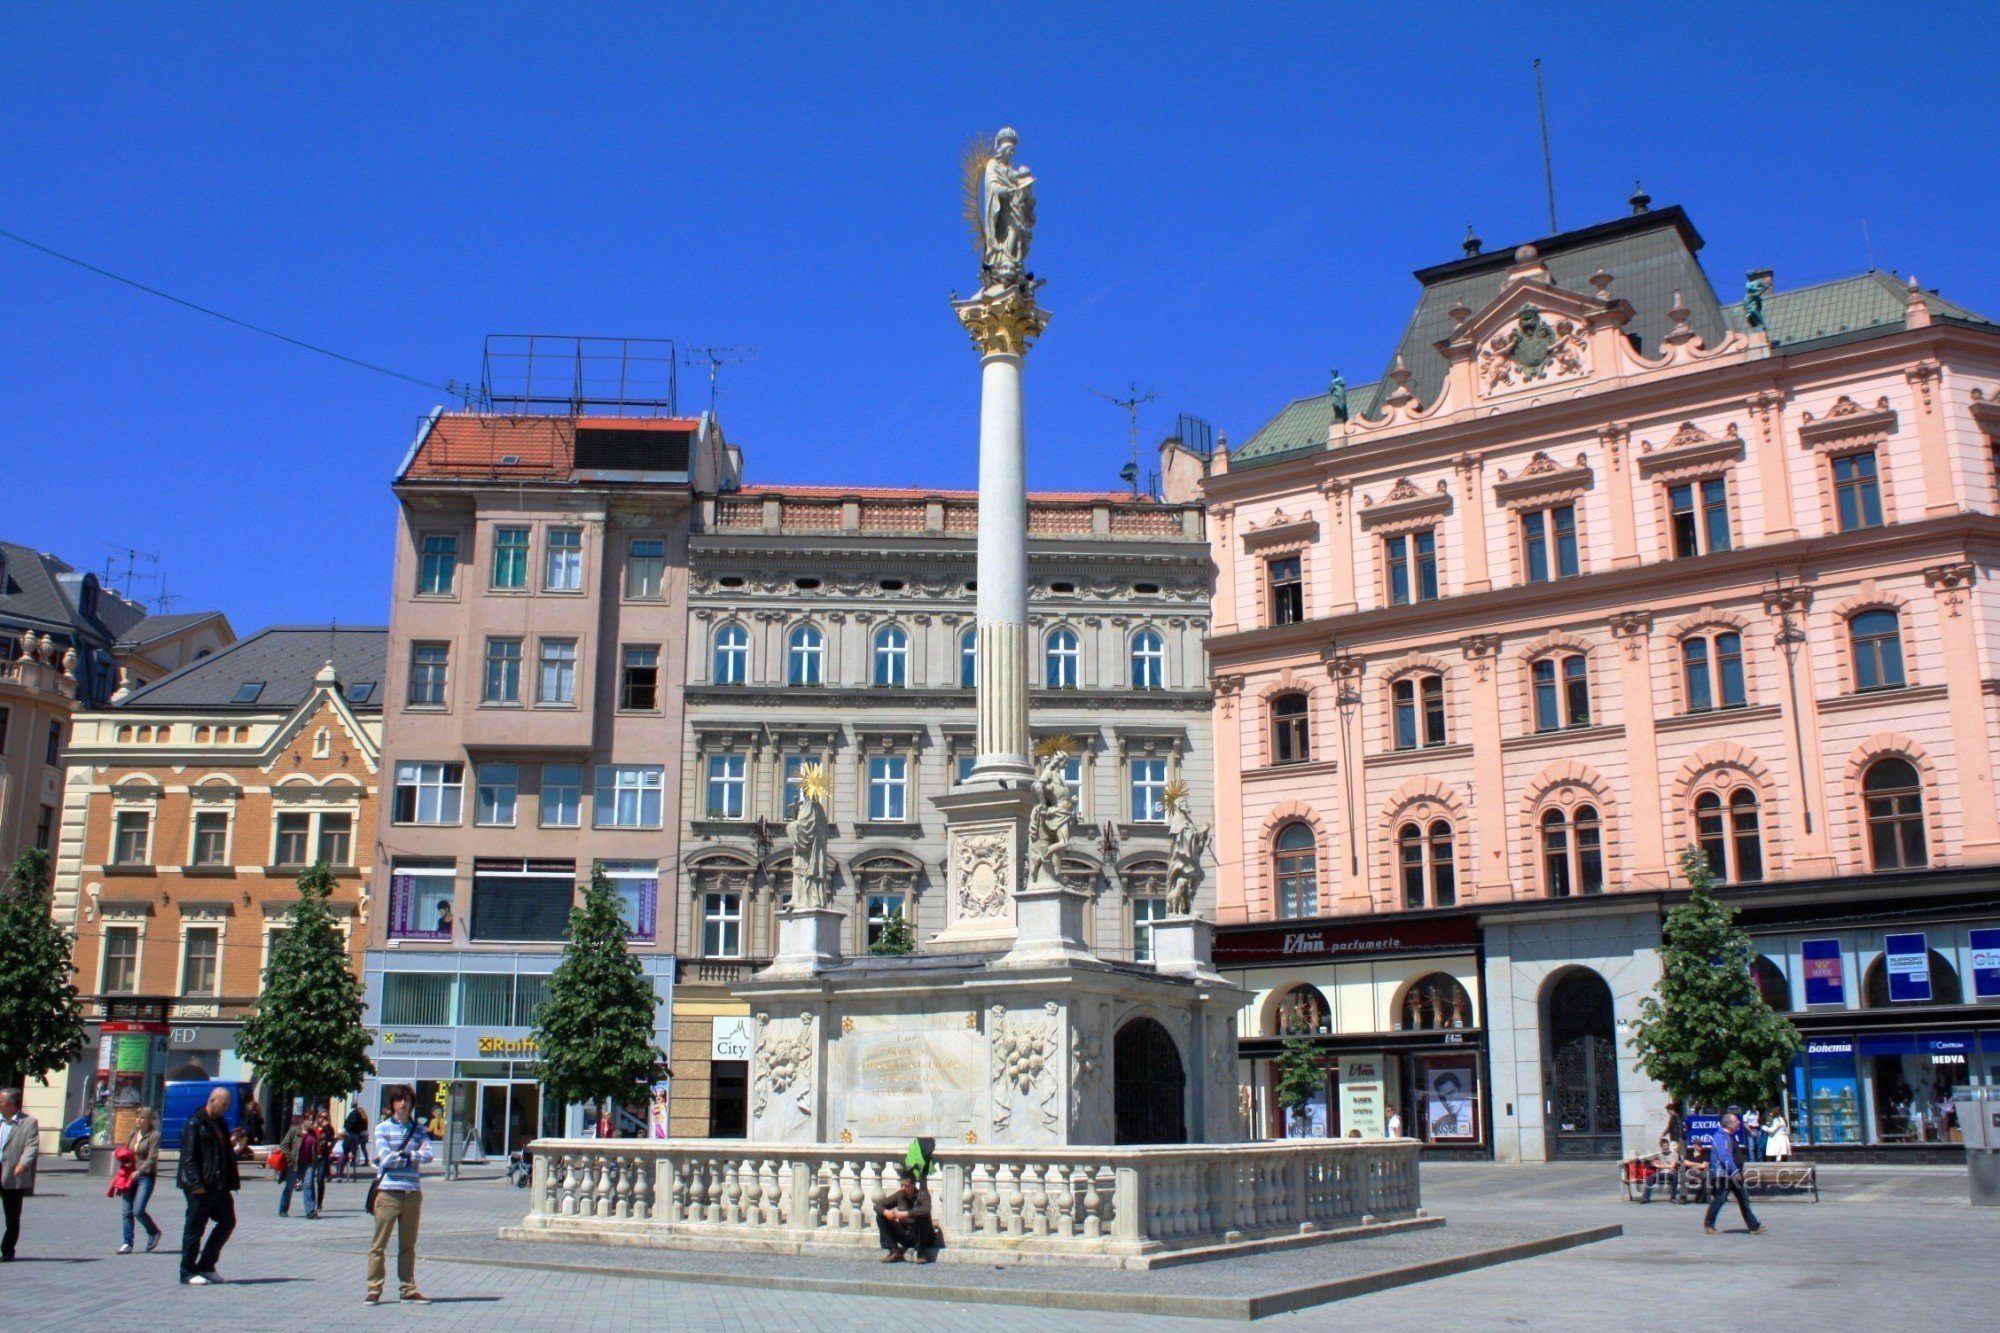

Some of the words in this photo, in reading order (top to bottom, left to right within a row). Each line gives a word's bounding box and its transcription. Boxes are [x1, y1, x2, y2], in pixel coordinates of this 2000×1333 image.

[1331, 937, 1401, 953] parfumerie
[495, 1036, 538, 1051] Raiff
[717, 1042, 747, 1059] City
[1808, 1040, 1852, 1053] Bohemia
[1931, 1055, 1965, 1064] HEDVA
[1691, 1120, 1721, 1129] EXCHA
